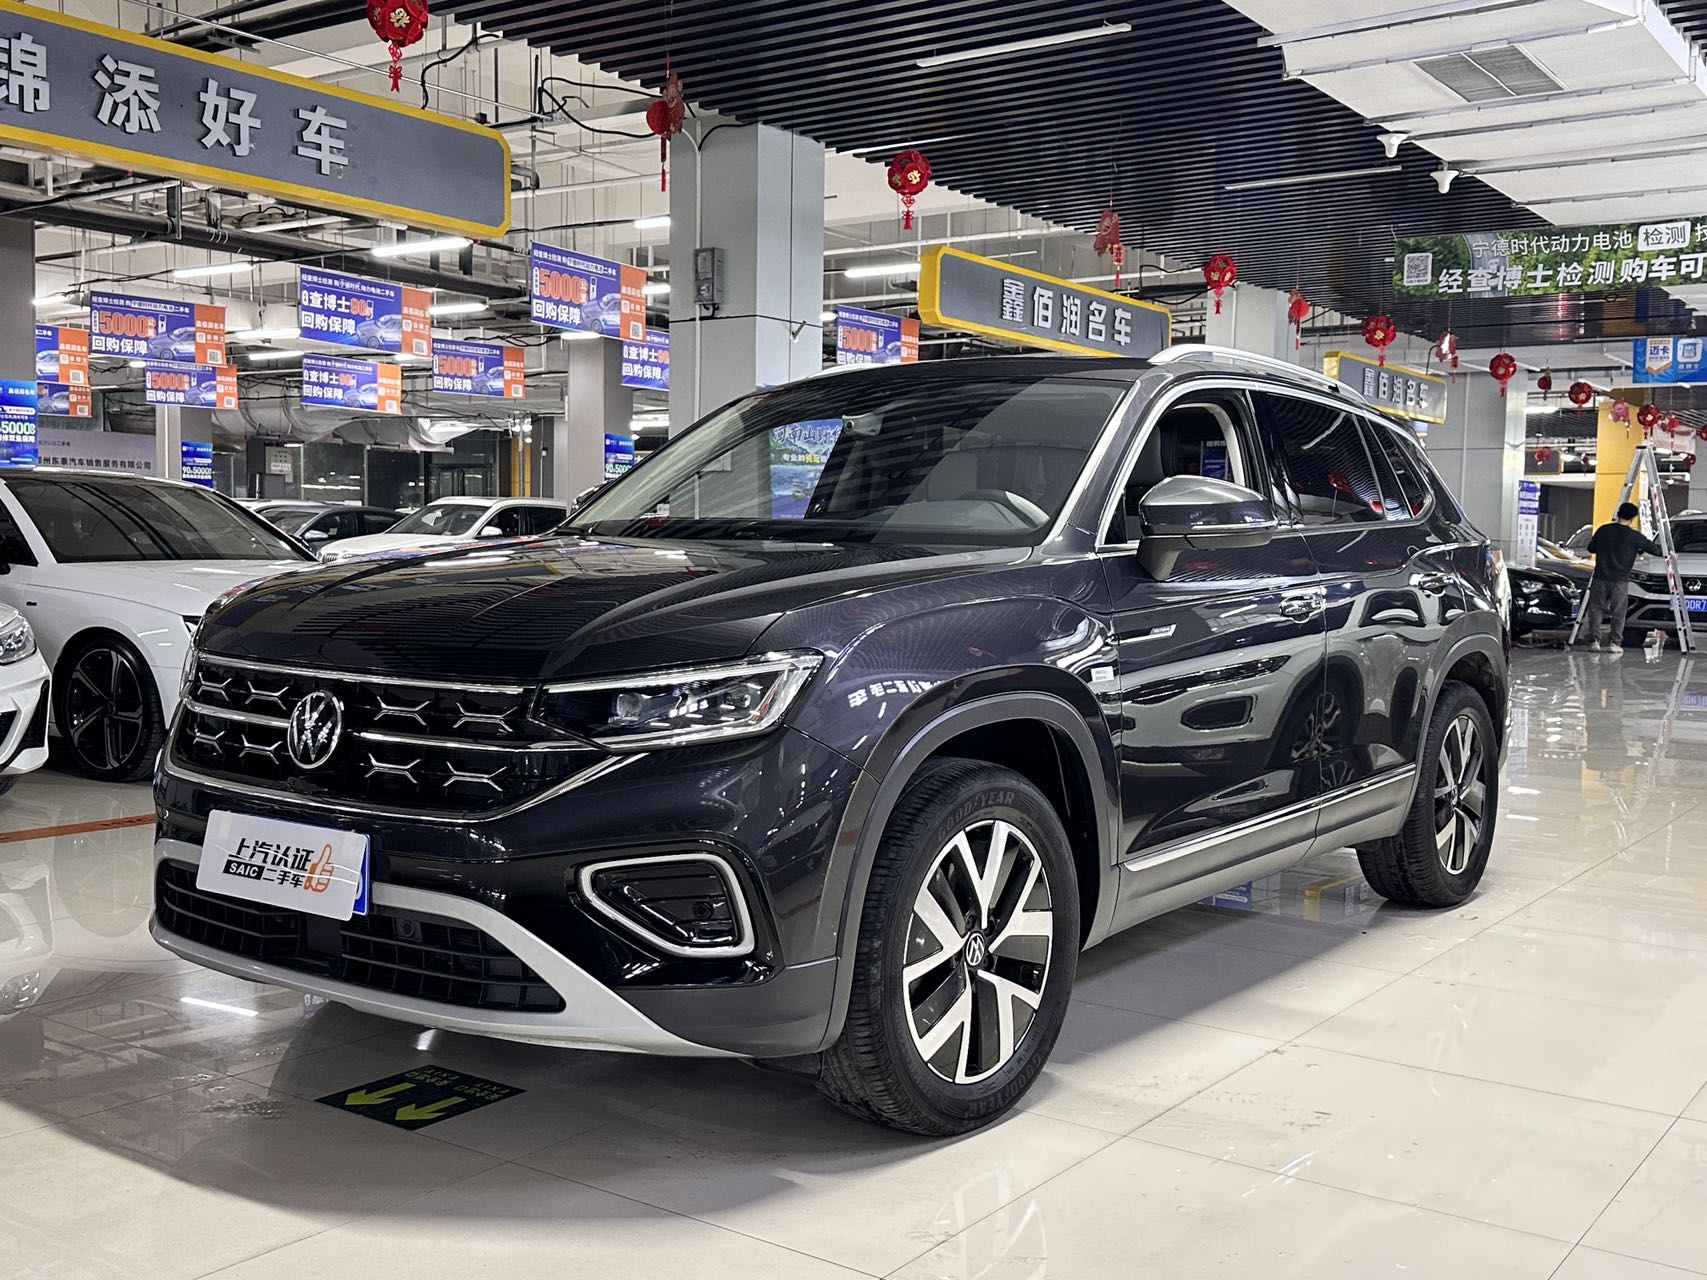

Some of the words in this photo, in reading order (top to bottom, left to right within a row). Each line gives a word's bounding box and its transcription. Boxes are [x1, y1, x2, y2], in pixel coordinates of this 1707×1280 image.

[1472, 230, 1633, 258] 宁德时代动力电池
[1643, 224, 1687, 246] 检测
[1438, 259, 1615, 294] 经查博士检测
[1619, 252, 1707, 283] 购车可
[532, 298, 582, 326] 回购保障
[1002, 278, 1132, 346] 鑫佰润名车
[301, 311, 357, 336] 回购保障
[91, 335, 149, 355] 回购保障
[622, 362, 662, 380] 回购保障
[303, 384, 344, 400] 回购保障
[433, 376, 473, 391] 回购保障
[146, 389, 186, 403] 回购保障
[229, 837, 315, 872] 上汽认证
[229, 861, 260, 877] SAIC
[262, 867, 306, 888] 二手车
